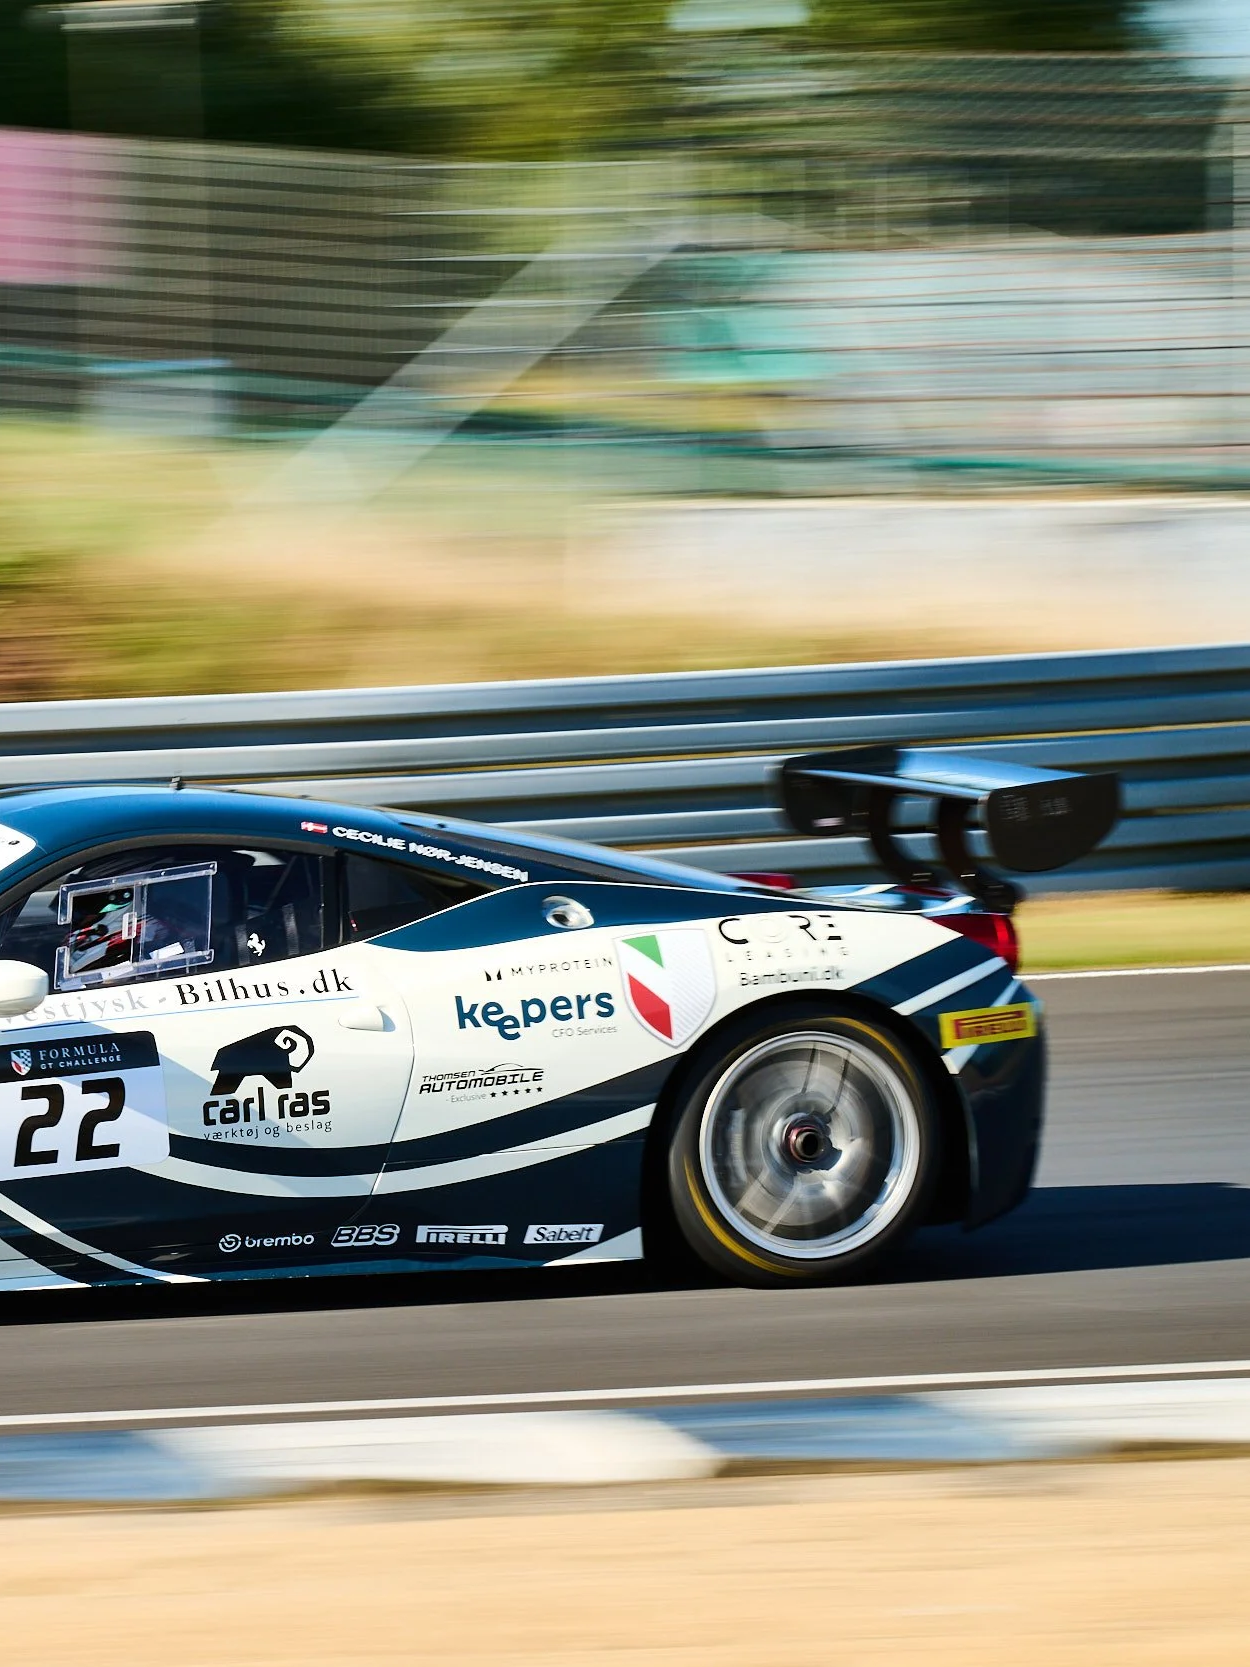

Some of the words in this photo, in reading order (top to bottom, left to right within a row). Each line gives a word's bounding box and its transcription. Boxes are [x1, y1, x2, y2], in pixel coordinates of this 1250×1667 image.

[332, 826, 406, 850] CECILIE
[511, 957, 614, 977] MYPROTEIN
[455, 992, 615, 1041] keepers
[551, 1027, 575, 1038] CFO
[577, 1025, 618, 1036] Services
[39, 1042, 121, 1060] FORMULA
[59, 1054, 122, 1068] CHALLENGE
[419, 1070, 545, 1094] AUTOMOBILE
[422, 1070, 476, 1082] THOMSEN
[203, 1086, 266, 1126] carl
[277, 1090, 330, 1119] ras
[450, 1092, 487, 1102] Exclusive
[14, 1077, 126, 1167] 22
[203, 1126, 259, 1140] værktøj
[264, 1125, 280, 1138] og
[286, 1120, 332, 1133] beslag
[244, 1233, 315, 1248] brembo
[331, 1223, 401, 1247] BBS
[415, 1225, 509, 1245] PIRELLI
[533, 1226, 594, 1242] Sabelt
